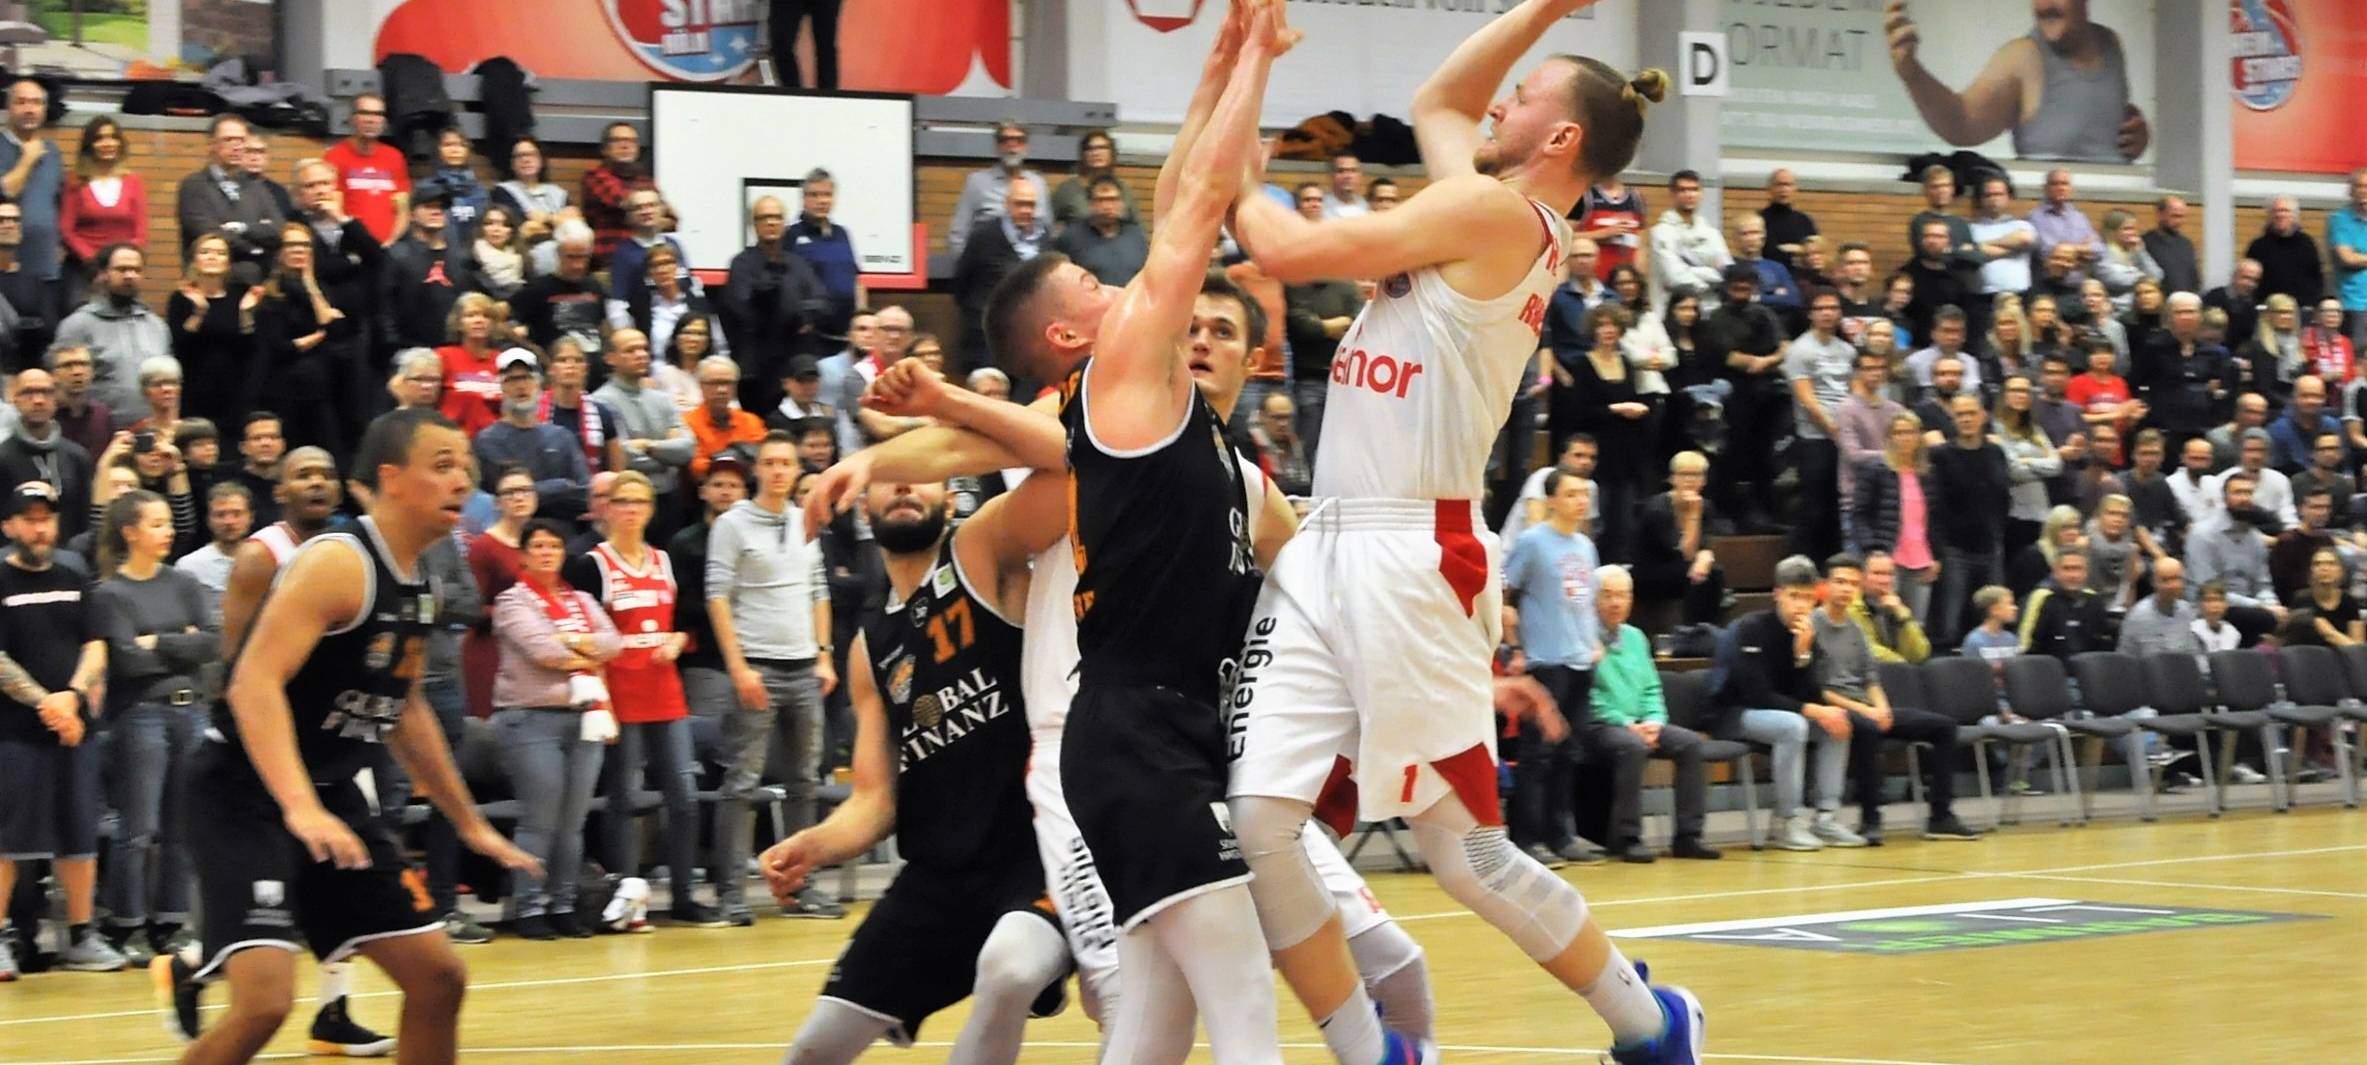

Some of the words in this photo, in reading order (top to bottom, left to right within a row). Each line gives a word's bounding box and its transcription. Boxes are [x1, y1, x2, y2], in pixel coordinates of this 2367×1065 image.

[1691, 42, 1718, 86] D
[1730, 23, 1869, 71] ORMAT
[926, 596, 976, 665] 17
[1226, 614, 1278, 765] Energie
[1400, 764, 1418, 803] 1
